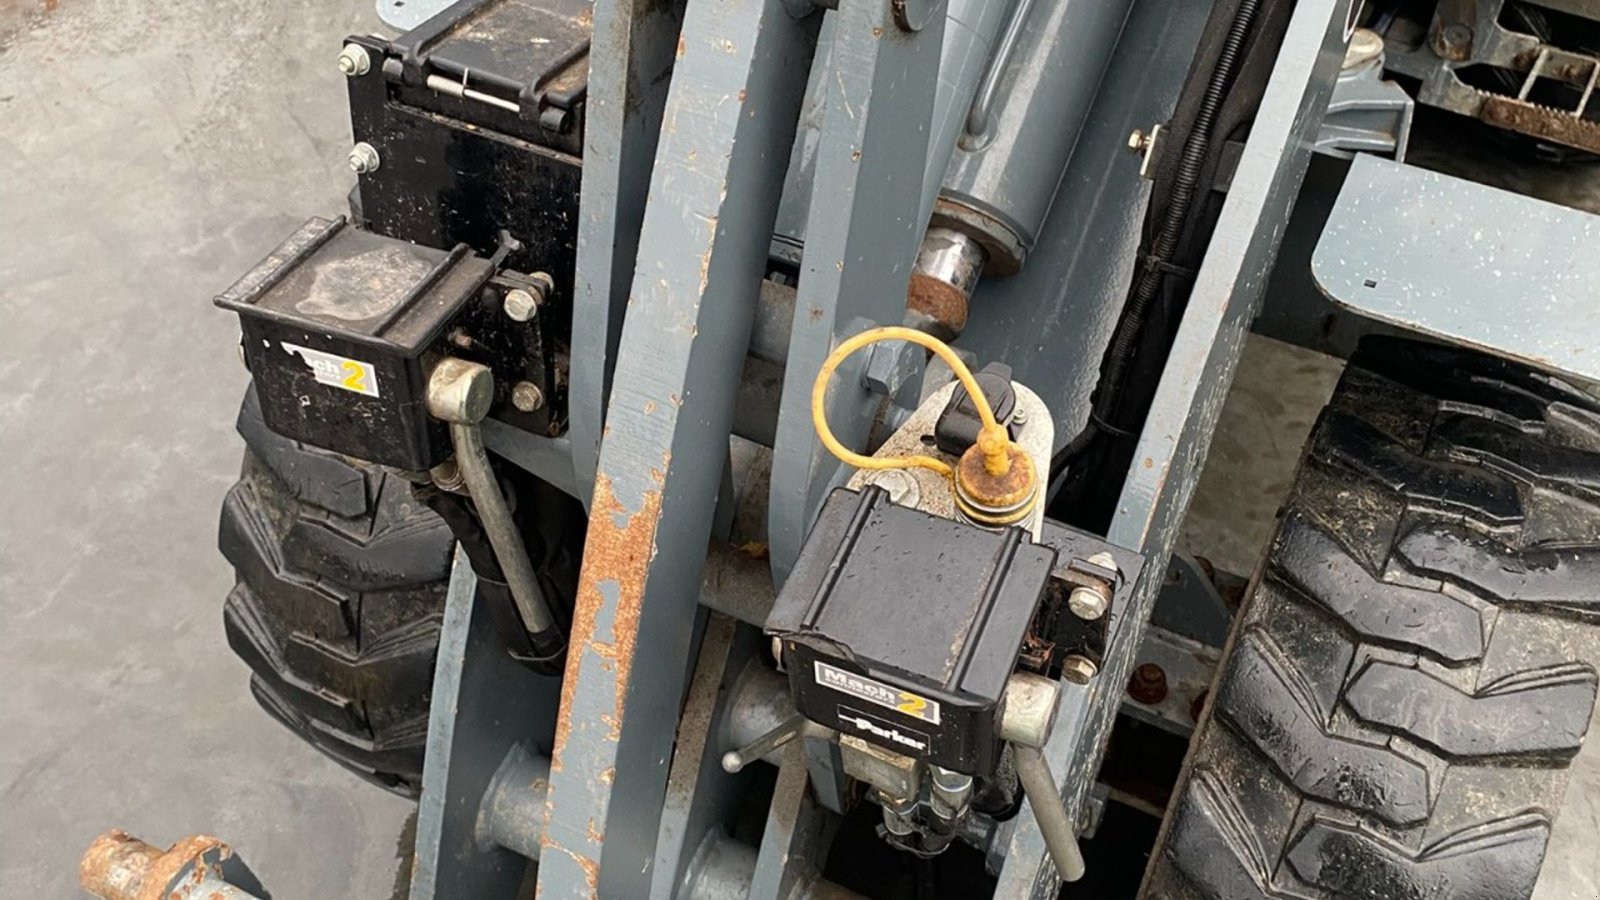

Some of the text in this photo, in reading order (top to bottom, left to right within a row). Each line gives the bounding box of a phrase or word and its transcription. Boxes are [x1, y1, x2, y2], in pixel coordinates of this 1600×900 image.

[342, 359, 366, 391] 2
[824, 668, 927, 718] Mach 2
[855, 717, 927, 750] Parker
